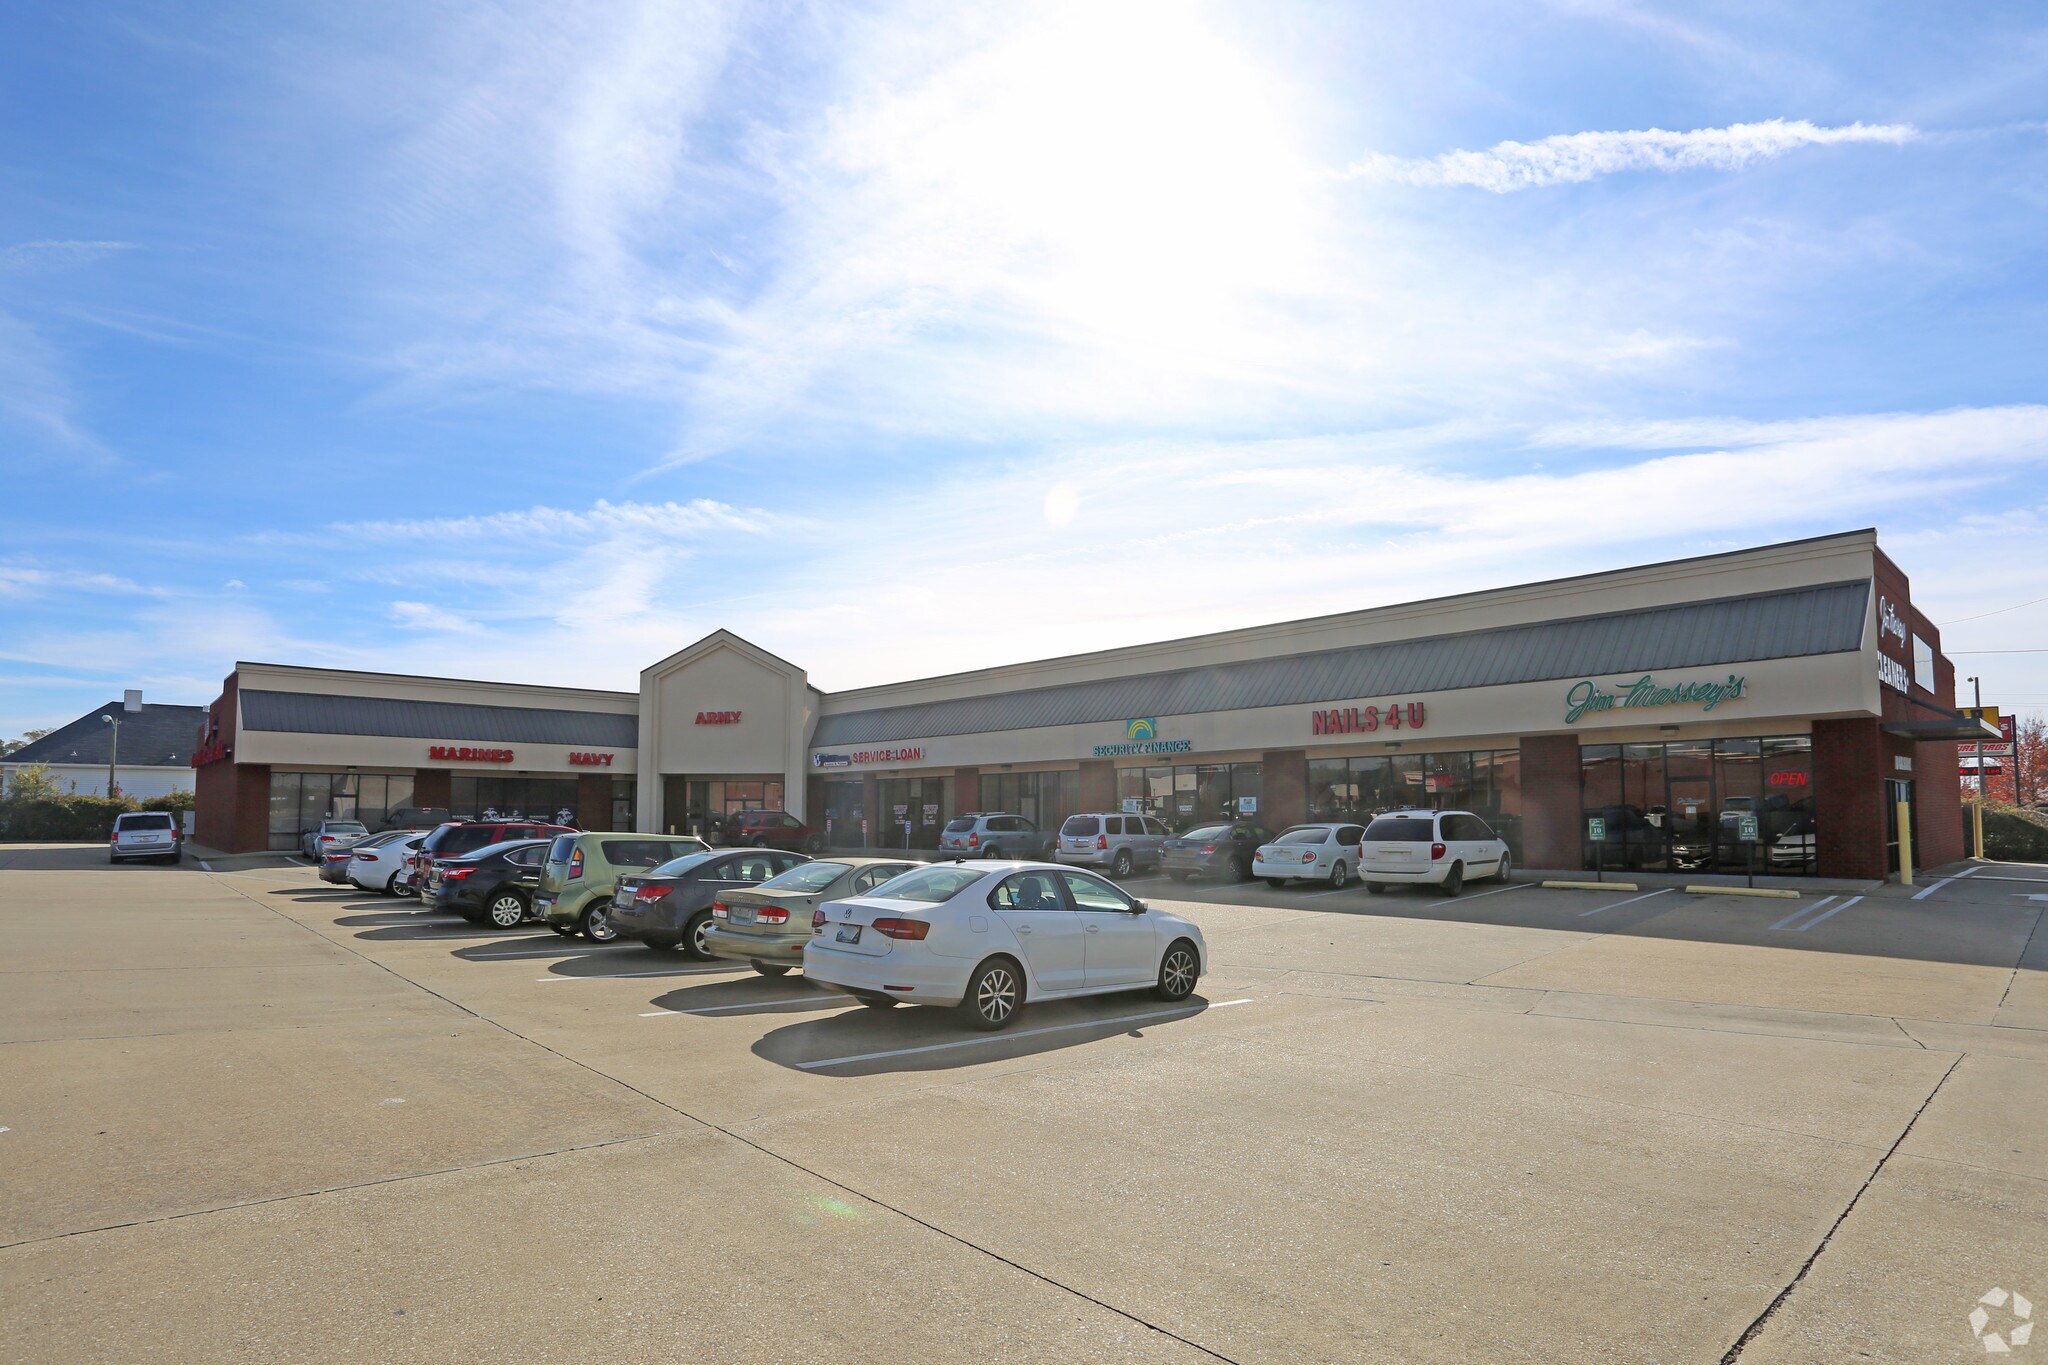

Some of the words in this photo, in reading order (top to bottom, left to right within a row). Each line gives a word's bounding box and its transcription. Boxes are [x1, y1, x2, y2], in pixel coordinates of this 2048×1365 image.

[1565, 680, 1616, 724] Jim
[1616, 674, 1746, 711] Massey's
[695, 710, 742, 725] ARMY
[1312, 705, 1378, 735] NAILS
[1385, 703, 1400, 730] 4
[1407, 702, 1424, 729] U
[429, 746, 514, 763] MARINES
[853, 750, 891, 763] SERVICE
[896, 747, 921, 760] LOAN
[1093, 743, 1142, 757] SECURITY
[1143, 740, 1191, 754] FINANCE
[569, 752, 614, 766] NAVY
[1770, 772, 1807, 785] OPEN
